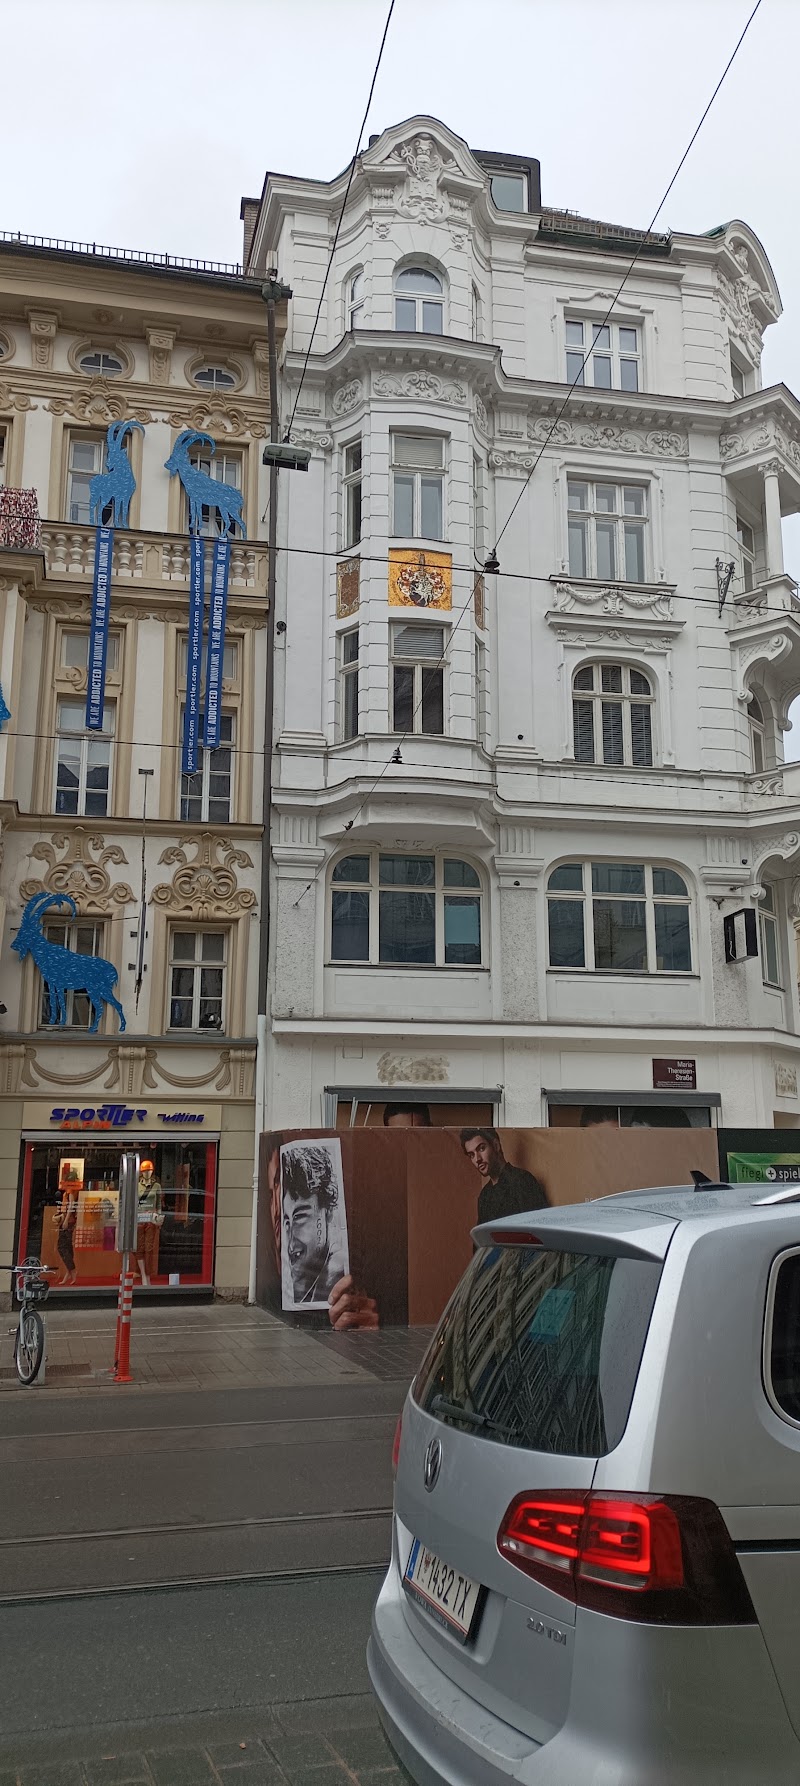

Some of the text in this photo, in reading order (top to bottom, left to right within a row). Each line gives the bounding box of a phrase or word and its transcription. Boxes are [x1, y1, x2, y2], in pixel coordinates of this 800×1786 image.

[96, 574, 108, 608] ADDICTED
[194, 561, 202, 606] sportler.com
[213, 596, 224, 630] ADDICTED
[192, 610, 200, 660] sportler.com
[91, 669, 102, 705] ADDICTED
[188, 665, 197, 715] sportler.com
[90, 706, 100, 717] ARE
[208, 690, 218, 725] ADDICTED
[187, 720, 195, 770] sportler.com
[206, 737, 216, 745] WE
[207, 726, 217, 736] ARE
[50, 1104, 148, 1126] SPORTLER
[60, 1120, 112, 1130] ALPIN
[741, 1166, 764, 1182] fiegl
[427, 1556, 455, 1605] 1432
[453, 1575, 472, 1621] TX
[545, 1626, 567, 1647] TDI
